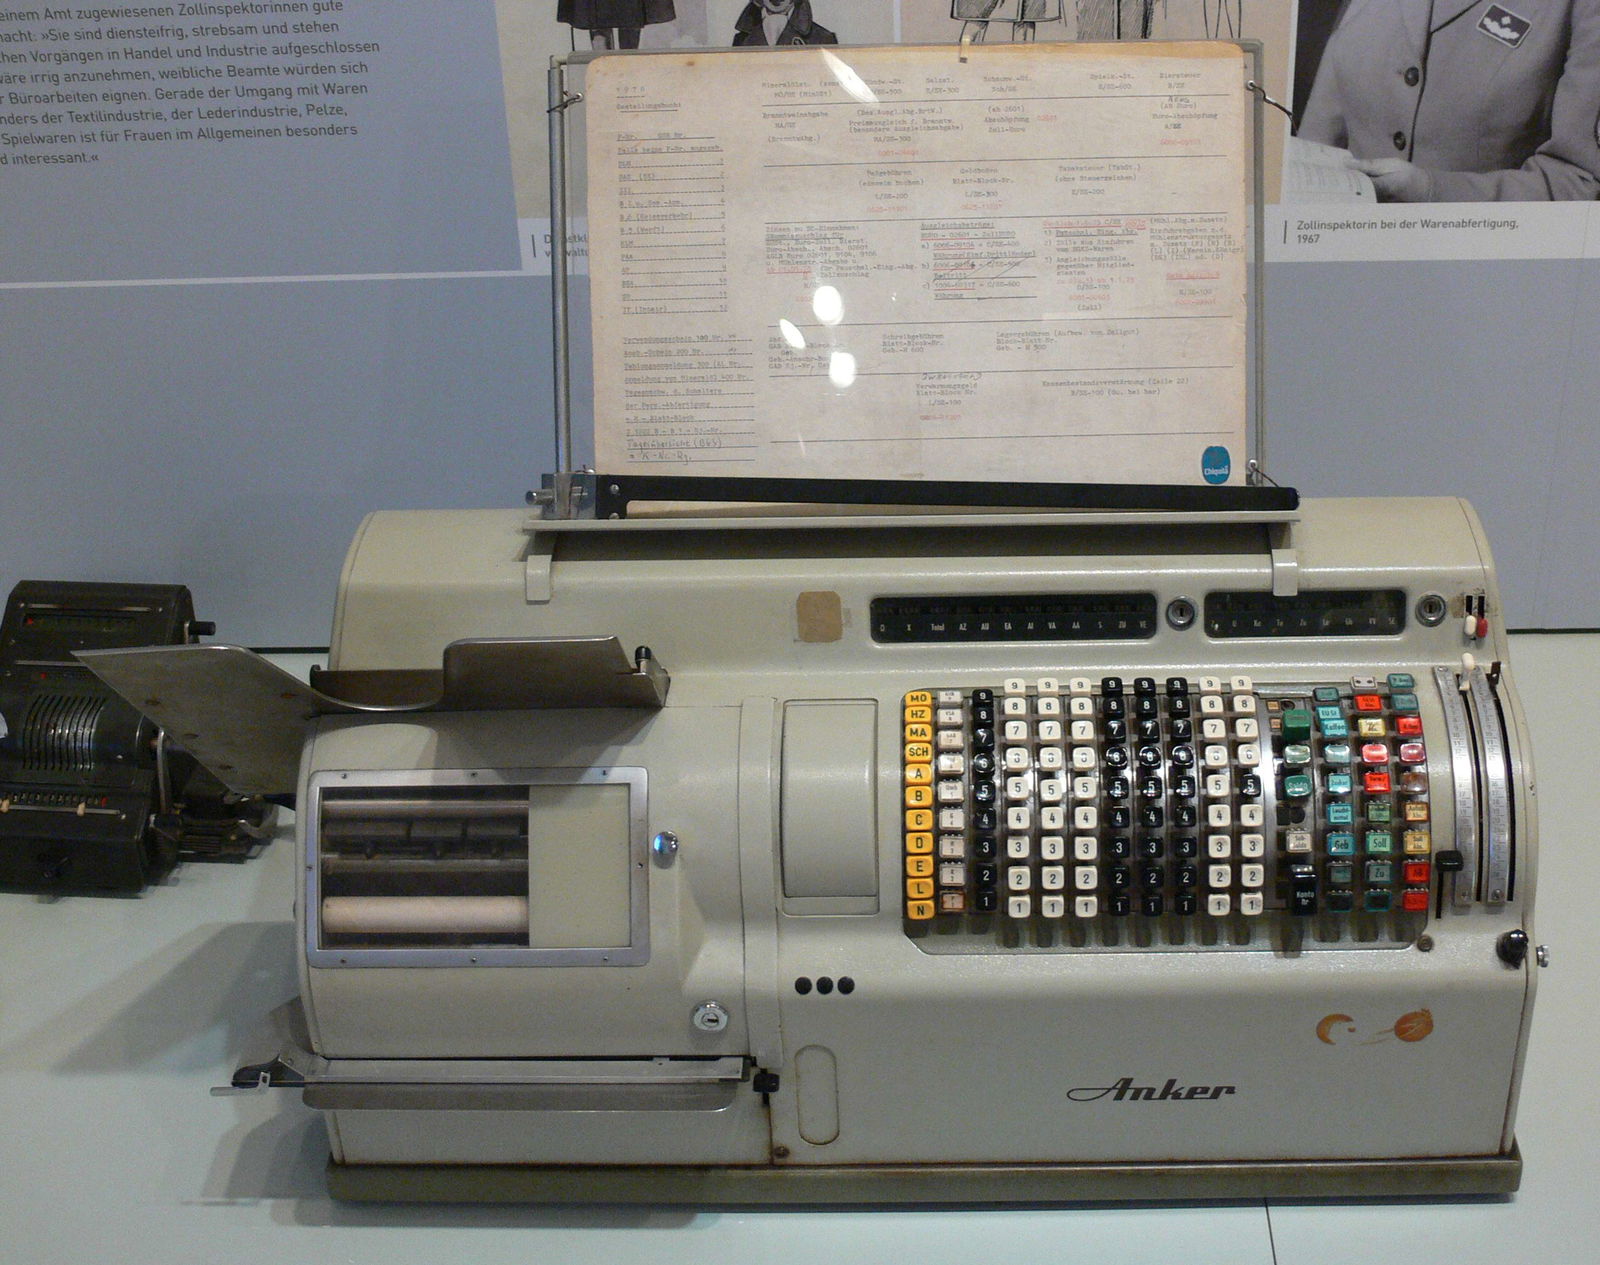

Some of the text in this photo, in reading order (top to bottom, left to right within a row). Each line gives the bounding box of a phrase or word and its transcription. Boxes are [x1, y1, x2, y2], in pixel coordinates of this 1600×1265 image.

[44, 8, 72, 20] Amt
[77, 7, 174, 22] zugewiesenen
[178, 2, 308, 17] Zollinspektorinnen
[313, 0, 343, 15] gute
[74, 28, 102, 40] sind
[107, 26, 188, 40] diensteifrig,
[192, 23, 258, 36] strebsam
[263, 23, 288, 34] und
[292, 21, 339, 33] stehen
[30, 48, 103, 64] Vorgängen
[108, 49, 120, 60] in
[124, 47, 172, 59] Handel
[176, 46, 202, 58] und
[206, 45, 267, 57] Industrie
[272, 42, 380, 57] aufgeschlossen
[30, 72, 59, 86] irrig
[64, 69, 155, 82] anzunehmen,
[158, 66, 223, 80] weibliche
[227, 64, 280, 77] Beamte
[283, 63, 336, 75] würden
[340, 61, 368, 73] sich
[102, 91, 151, 104] eignen.
[155, 88, 204, 100] Gerade
[209, 87, 231, 99] der
[235, 86, 293, 100] Umgang
[297, 84, 319, 96] mit
[322, 83, 368, 95] Waren
[42, 112, 64, 123] der
[68, 110, 167, 123] Textilindustrie,
[171, 108, 193, 120] der
[198, 108, 302, 120] Lederindustrie,
[306, 104, 347, 117] Pelze,
[2, 124, 358, 147] Spielwaren ist für Frauen im Allgemeinen besonders
[1297, 220, 1377, 232] Zollinspektorin
[1381, 219, 1396, 229] bei
[1400, 219, 1418, 229] der
[1297, 234, 1320, 243] 1967
[911, 710, 926, 718] HZ
[980, 711, 986, 719] 8
[1111, 701, 1117, 710] 8
[1144, 701, 1150, 709] 8
[1209, 700, 1215, 708] 8
[1242, 700, 1248, 708] 8
[910, 728, 927, 736] MA
[981, 723, 1250, 743] 7 7 7 7 7 7 7 7 7
[909, 748, 928, 756] SCH
[915, 768, 922, 779] A
[915, 790, 922, 801] B
[915, 814, 922, 825] C
[983, 810, 1254, 824] 4 4 4 4 4 4 4 4 4
[916, 837, 923, 848] D
[983, 840, 1257, 854] 3 3 3 3 3 3 3 3 3
[1334, 840, 1349, 849] Geb
[1373, 839, 1386, 848] Soll
[916, 861, 924, 872] E
[983, 870, 1256, 884] 2 2 2 2 2 2 2 2 2
[917, 883, 924, 894] L
[917, 906, 924, 916] N
[1066, 1077, 1236, 1101] Anker
